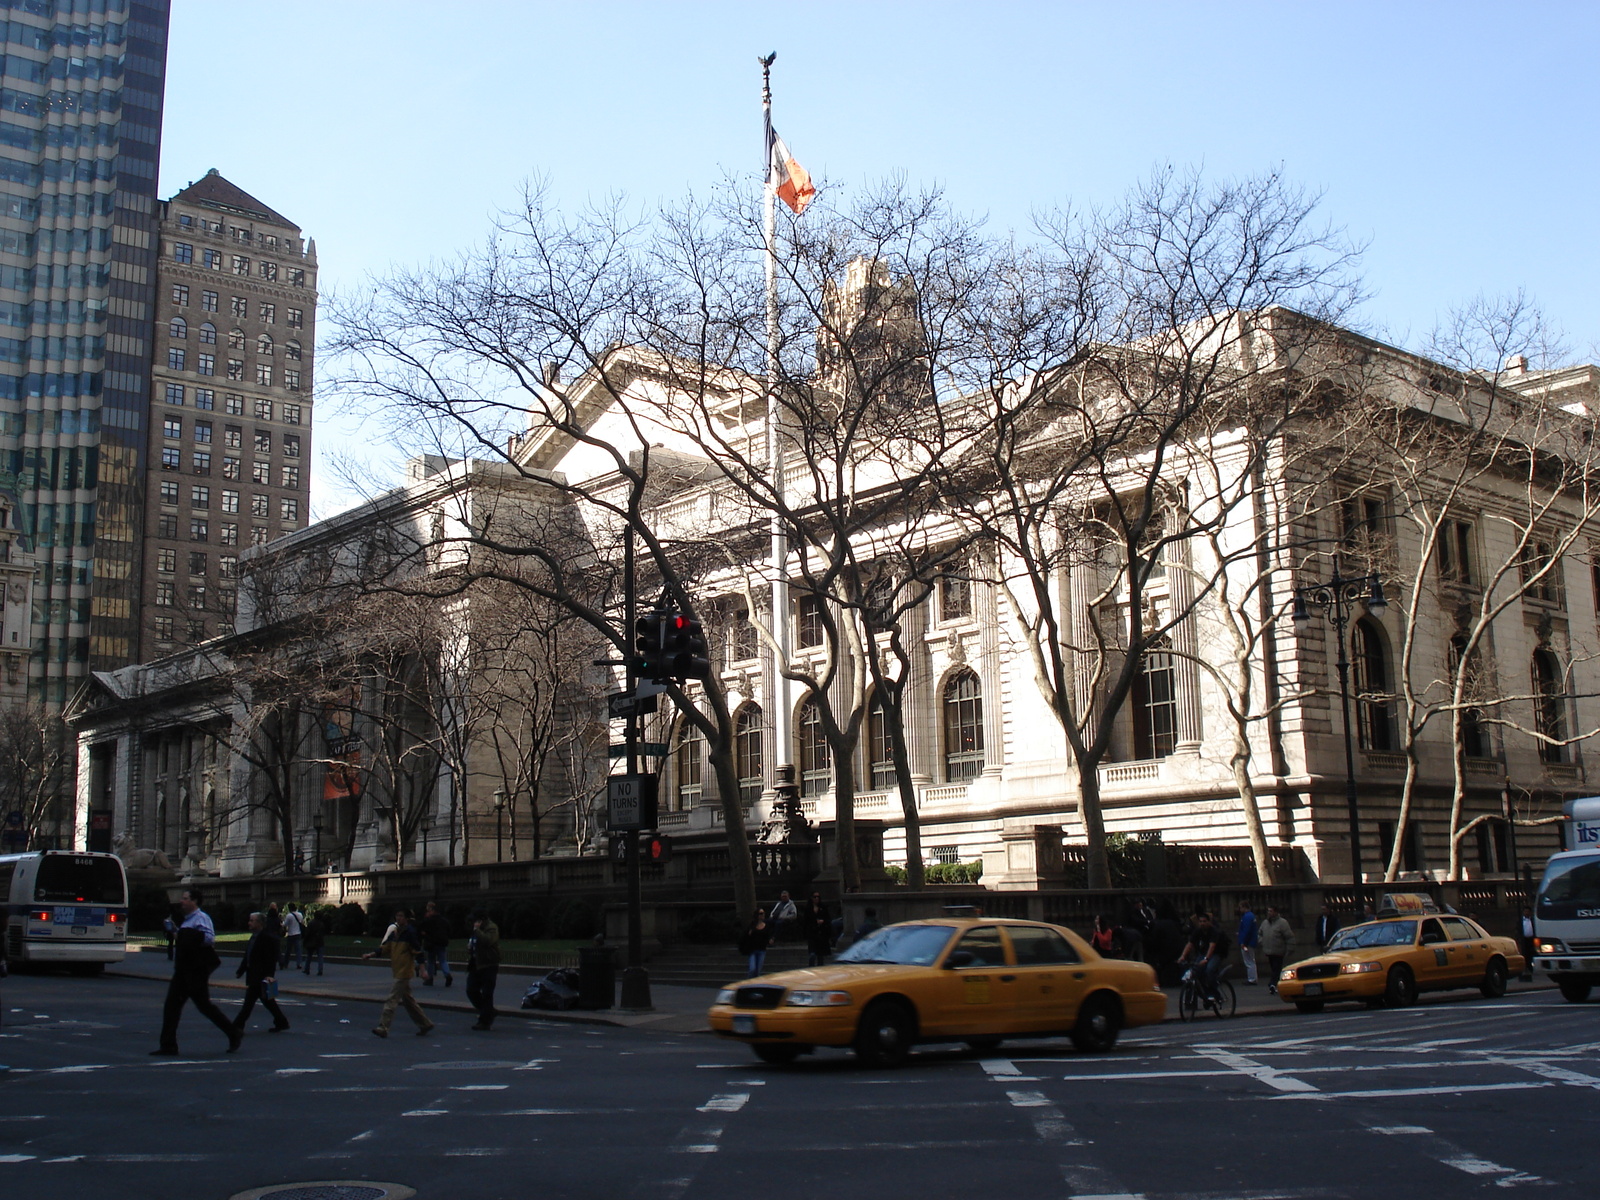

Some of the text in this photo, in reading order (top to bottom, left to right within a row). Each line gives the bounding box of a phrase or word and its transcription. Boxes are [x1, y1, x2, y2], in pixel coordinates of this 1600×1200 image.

[618, 783, 631, 795] NO
[612, 797, 637, 808] TURNS
[1577, 822, 1600, 843] its
